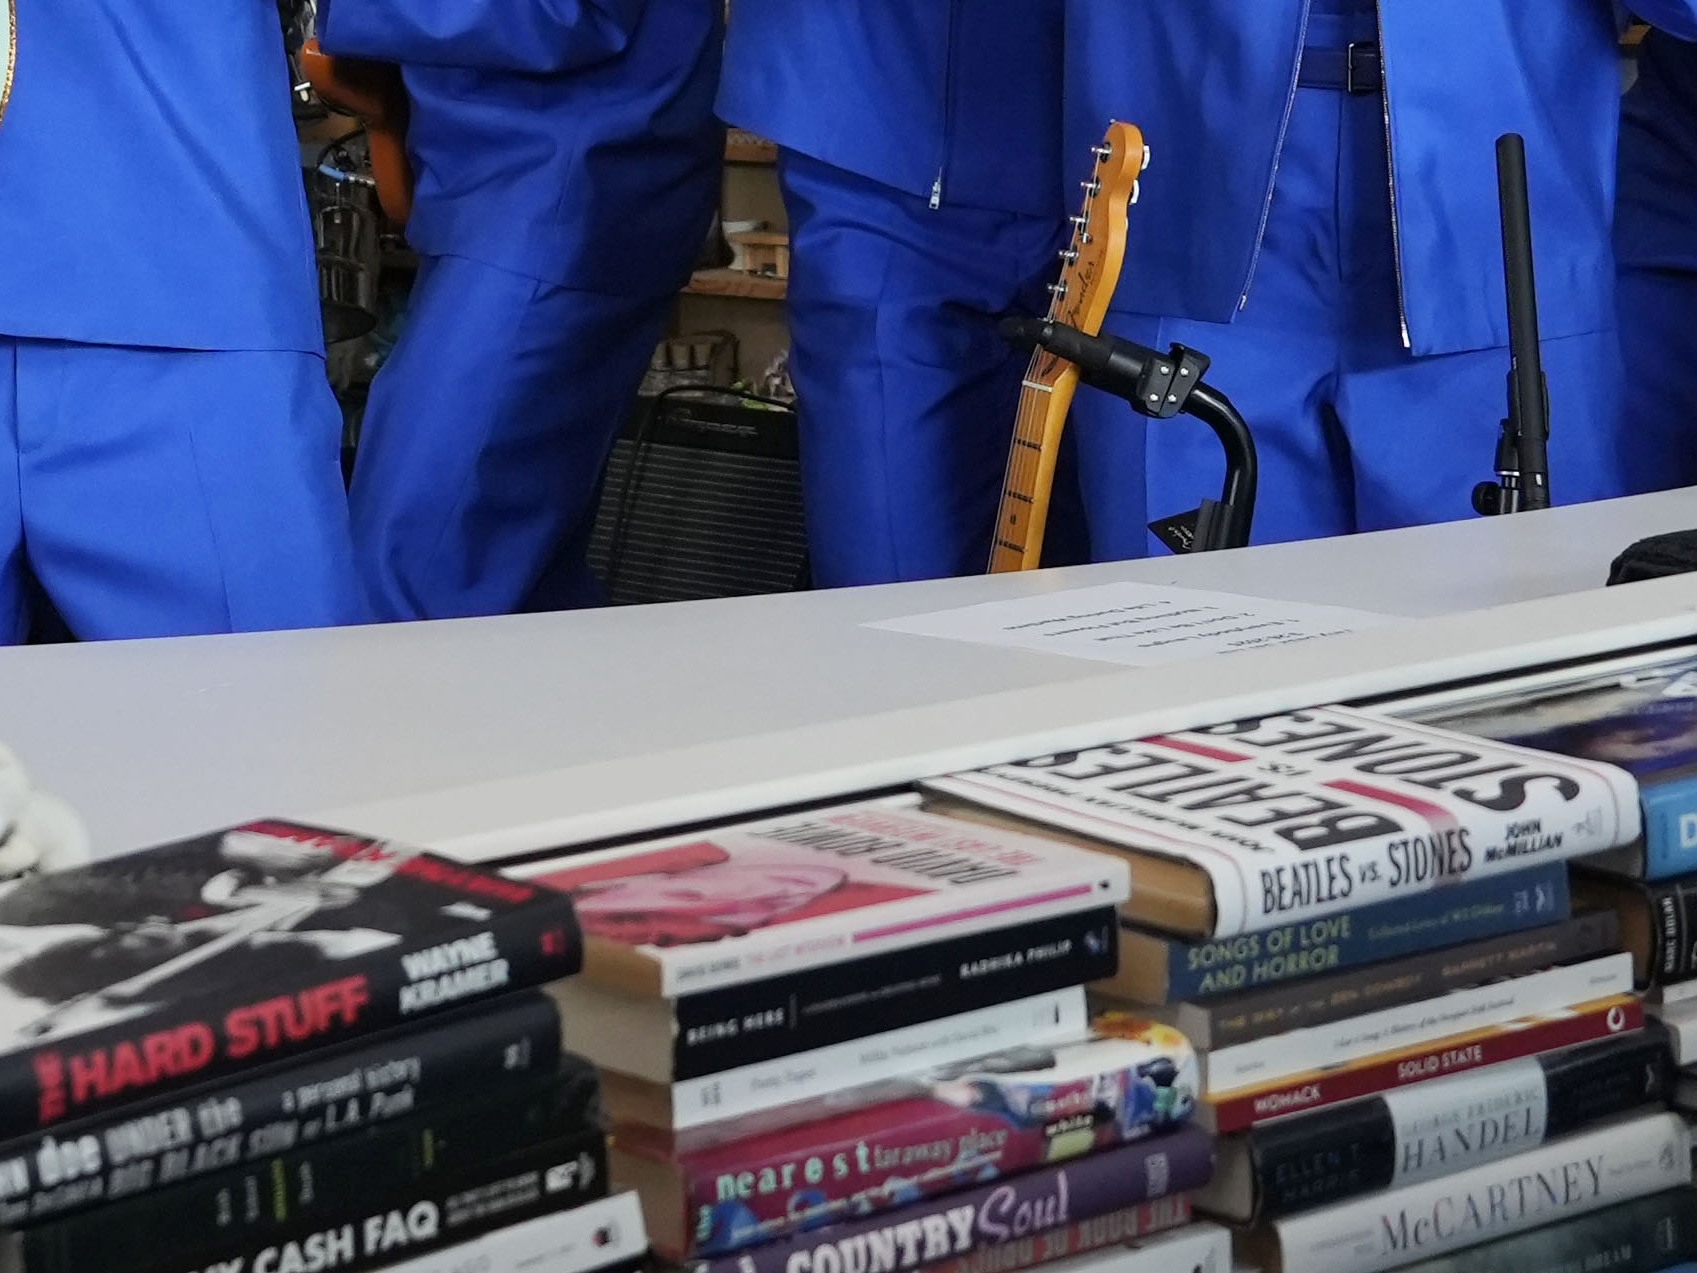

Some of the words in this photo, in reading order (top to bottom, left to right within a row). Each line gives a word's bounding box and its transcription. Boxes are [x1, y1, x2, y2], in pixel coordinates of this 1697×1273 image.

[1261, 852, 1353, 915] BEATLES
[1388, 827, 1473, 888] STONES
[403, 930, 498, 981] WAYNE
[1187, 937, 1261, 970] SONGS
[1267, 929, 1294, 954] OF
[1301, 915, 1351, 946] LOVE
[1199, 964, 1246, 991] AND
[1254, 944, 1340, 980] HORROR
[399, 958, 511, 1015] KRAMER
[71, 1022, 215, 1104] HARD
[226, 973, 371, 1059] STUFF
[1397, 1054, 1440, 1081] SOLID
[1443, 1044, 1483, 1069] STATE
[1254, 1081, 1322, 1114] WOMACK
[1403, 1105, 1536, 1175] HANDEL
[252, 1233, 354, 1273] CASH
[363, 1198, 440, 1253] FAQ
[978, 1170, 1070, 1240] Soul
[1382, 1153, 1605, 1257] McCARTNEY
